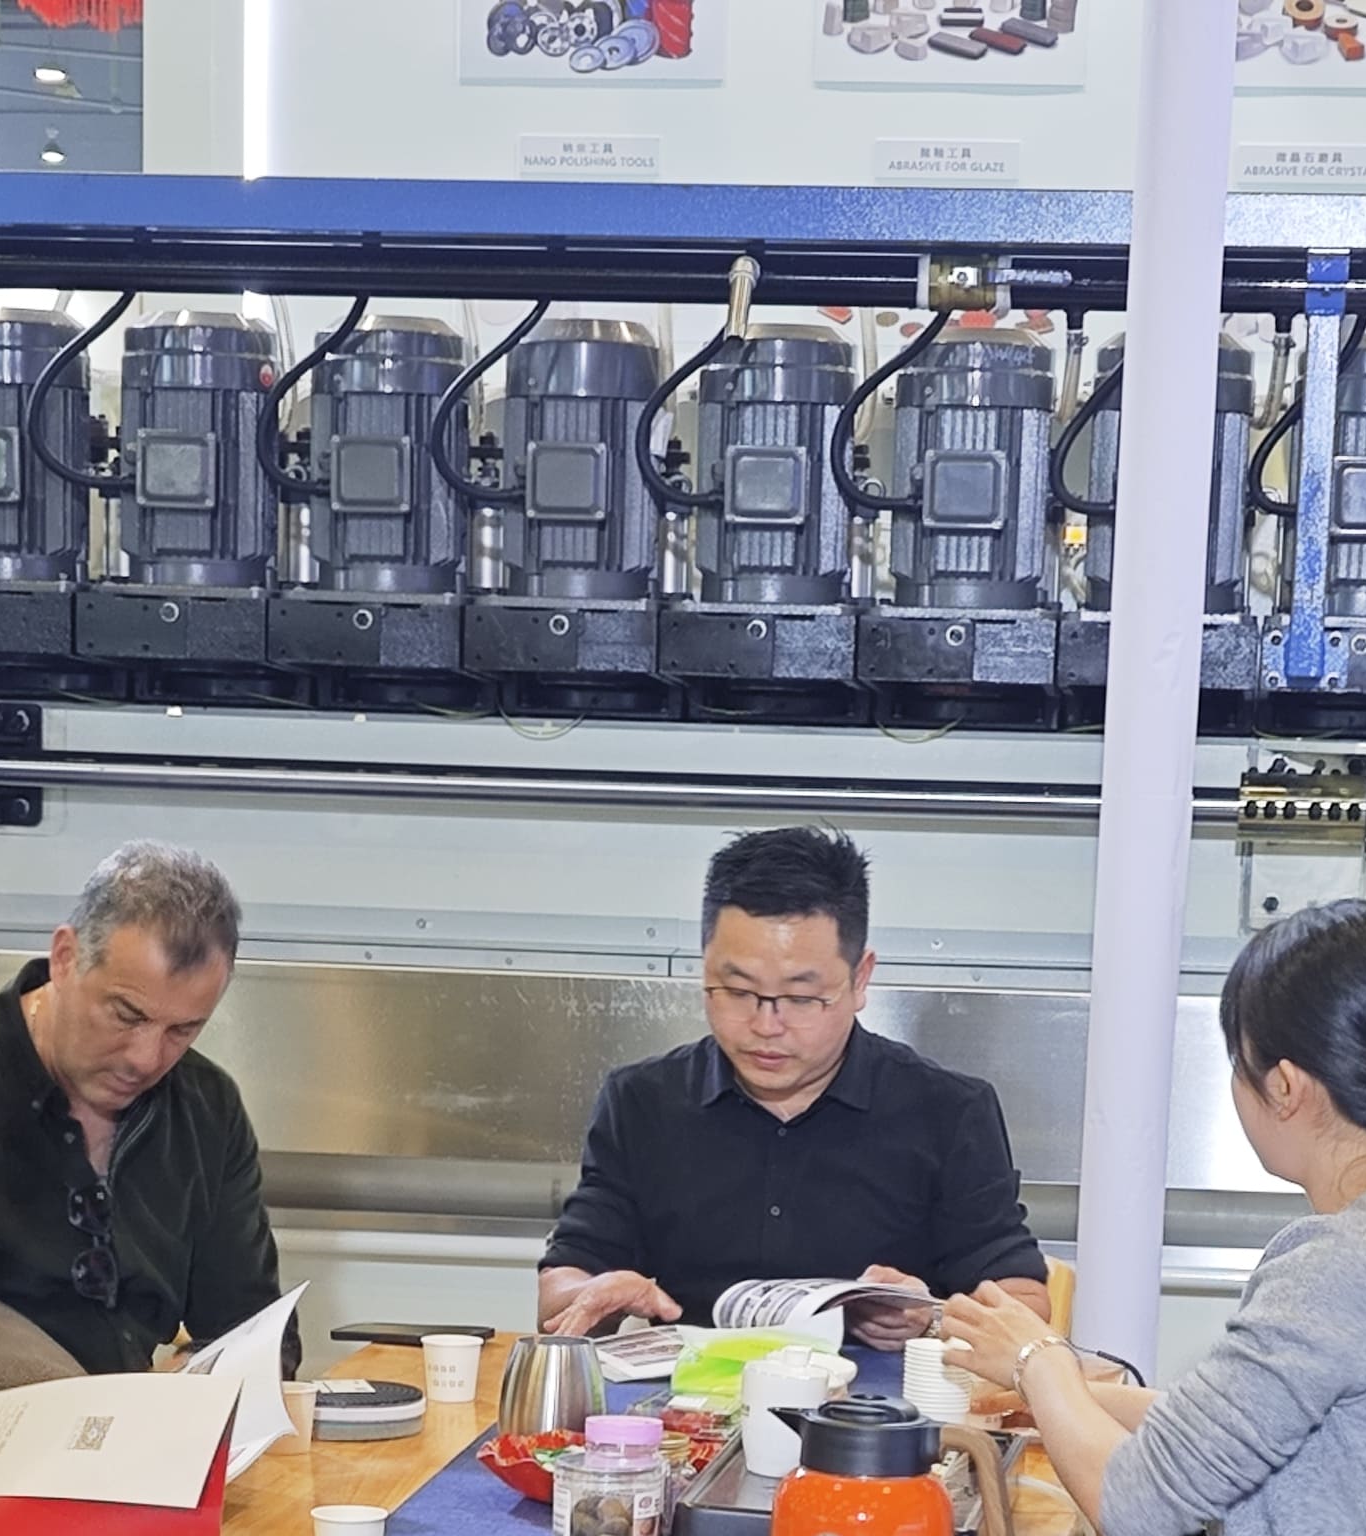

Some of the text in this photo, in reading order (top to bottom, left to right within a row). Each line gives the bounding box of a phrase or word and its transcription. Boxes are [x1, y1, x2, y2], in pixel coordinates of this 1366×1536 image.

[523, 156, 655, 168] NANO POLISHING TOOLS
[888, 161, 941, 172] ABRASIVE
[945, 161, 967, 172] FOR
[1244, 165, 1298, 176] ABRASIVE
[1302, 166, 1324, 176] FOR
